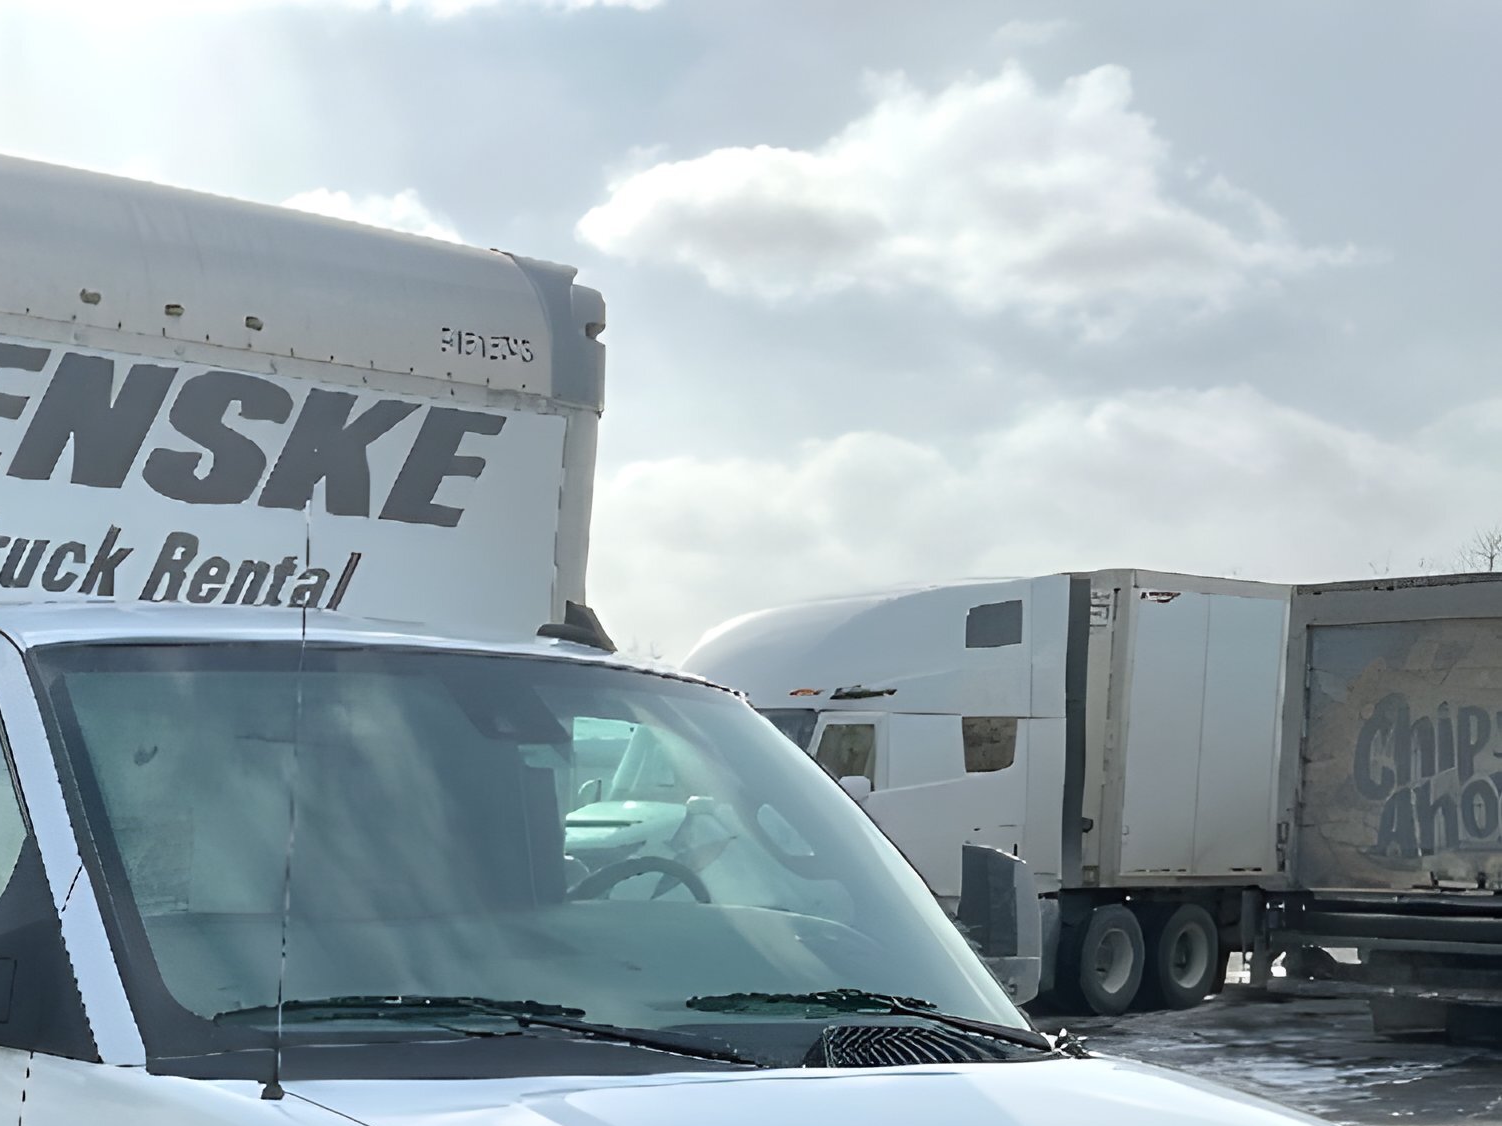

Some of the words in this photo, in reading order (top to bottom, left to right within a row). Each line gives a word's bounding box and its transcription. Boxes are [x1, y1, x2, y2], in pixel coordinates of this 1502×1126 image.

[139, 530, 362, 611] Rental
[1353, 692, 1502, 801] Chip
[1376, 772, 1502, 858] Aho
